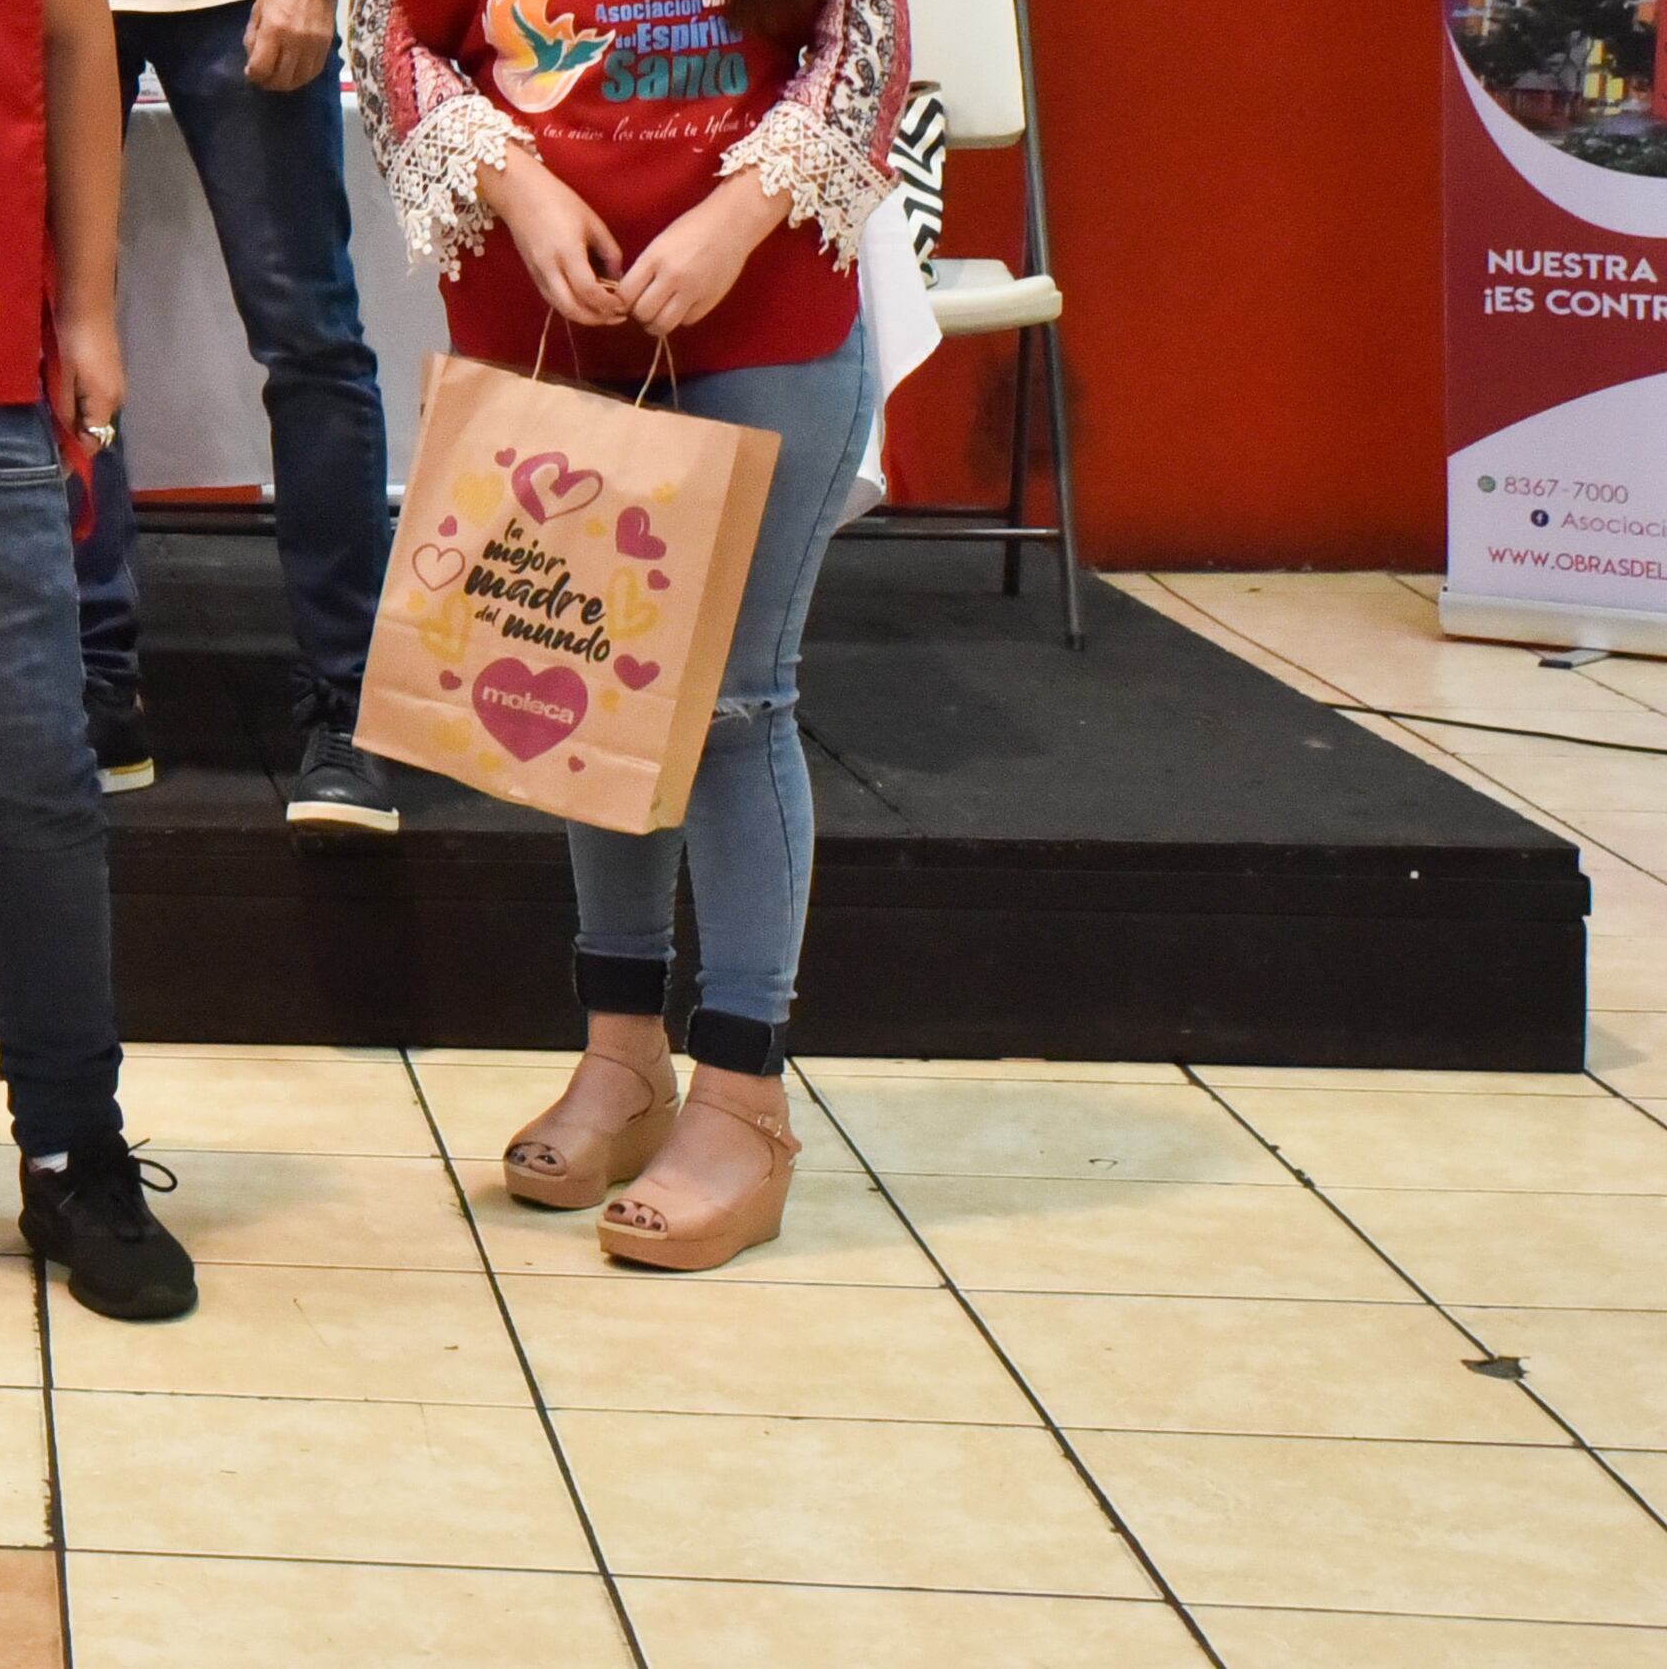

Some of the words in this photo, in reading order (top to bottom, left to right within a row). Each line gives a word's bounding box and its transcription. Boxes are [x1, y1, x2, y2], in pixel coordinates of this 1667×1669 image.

[601, 48, 748, 102] Santo
[1486, 248, 1656, 283] NUESTRA
[1482, 285, 1534, 315] ¡ES
[503, 517, 522, 541] la
[483, 536, 565, 575] mejor
[463, 565, 605, 624] madre
[473, 603, 500, 625] del
[501, 613, 610, 663] mundo
[480, 684, 575, 725] moleca
